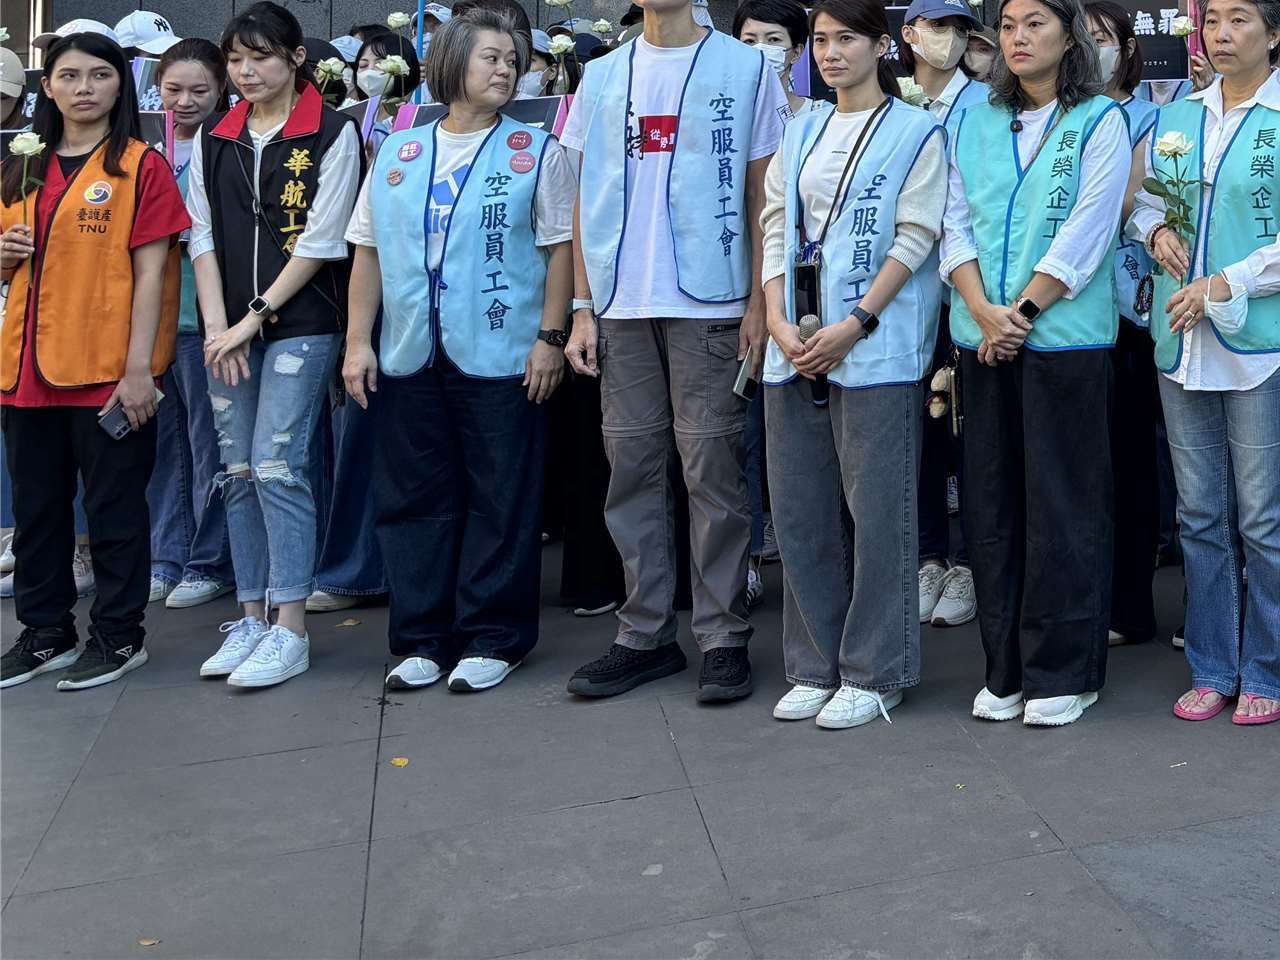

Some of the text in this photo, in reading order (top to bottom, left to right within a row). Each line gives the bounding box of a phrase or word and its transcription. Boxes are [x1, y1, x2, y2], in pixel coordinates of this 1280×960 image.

[78, 224, 108, 234] TNU
[709, 92, 740, 257] 空服員工會
[1043, 128, 1079, 241] 長榮企工
[1250, 126, 1278, 241] 長榮企工
[478, 171, 513, 331] 空服員工會
